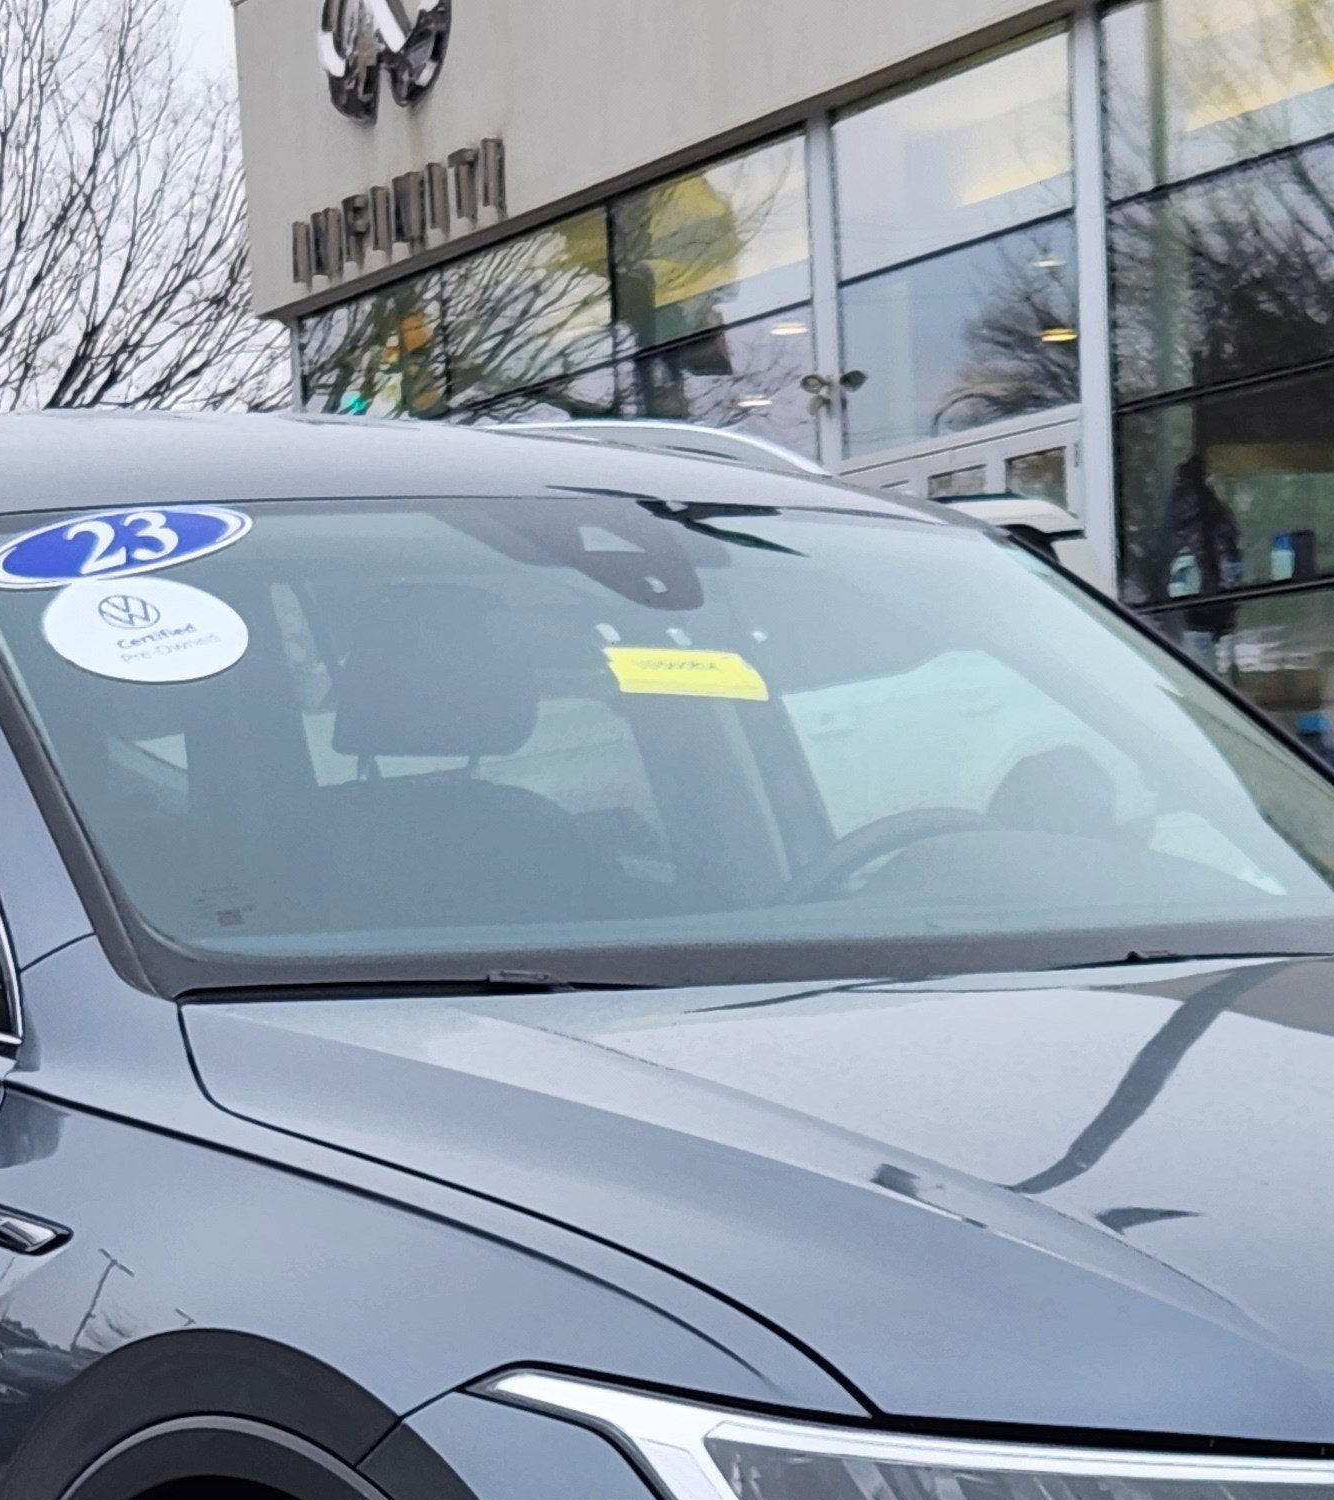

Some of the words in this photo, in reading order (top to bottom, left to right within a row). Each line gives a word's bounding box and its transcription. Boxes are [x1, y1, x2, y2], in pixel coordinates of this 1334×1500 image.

[292, 138, 507, 284] INFINITI
[66, 512, 179, 574] 23
[117, 623, 197, 649] Certified
